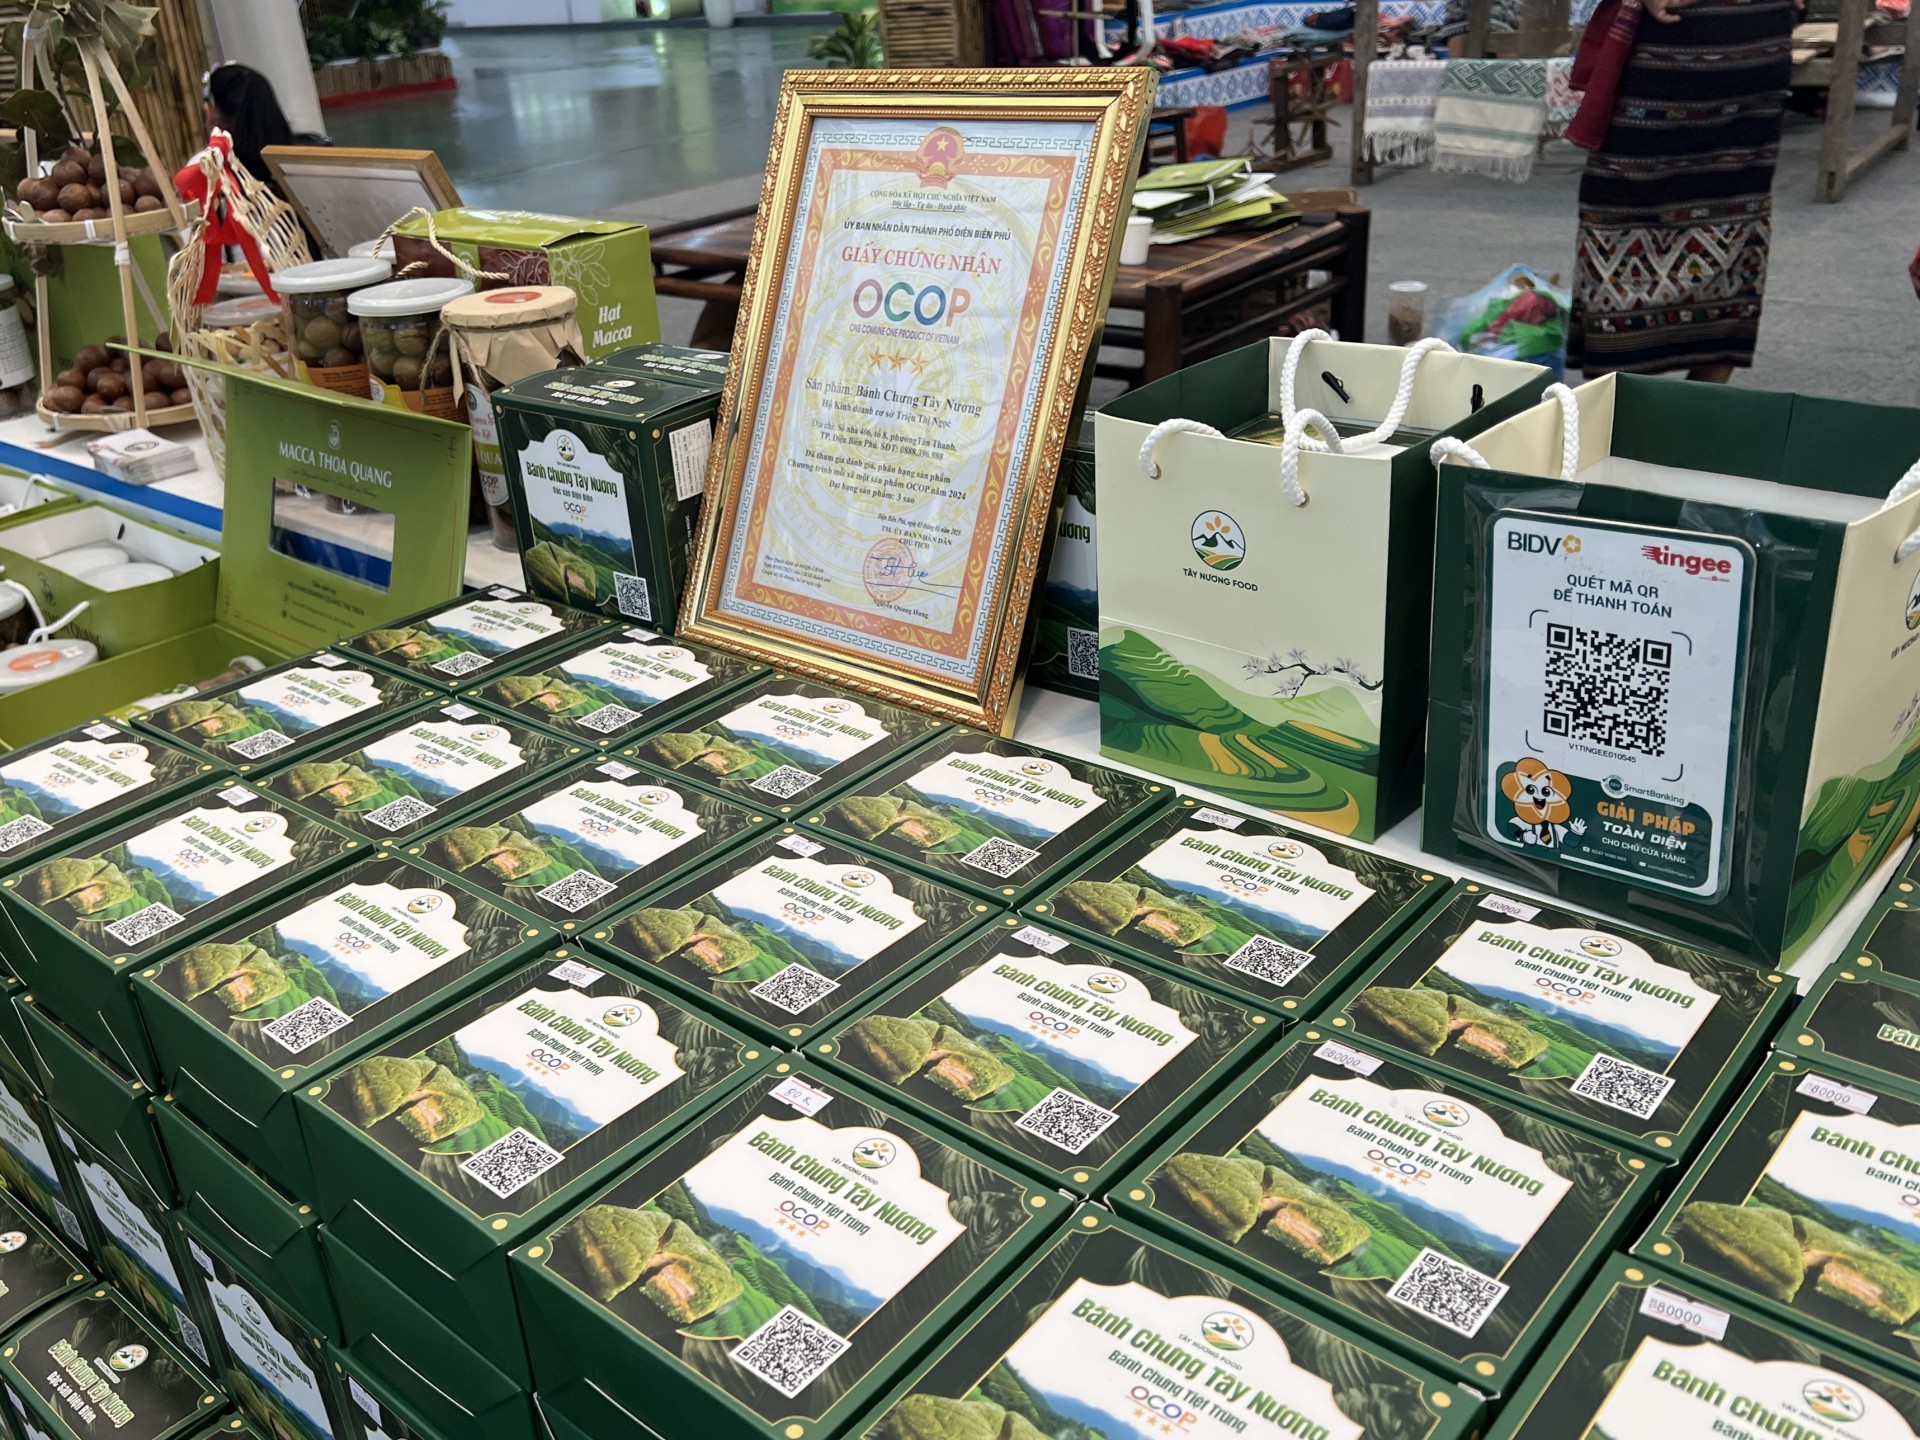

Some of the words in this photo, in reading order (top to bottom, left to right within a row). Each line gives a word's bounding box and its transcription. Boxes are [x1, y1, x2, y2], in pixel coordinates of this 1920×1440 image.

[855, 221, 870, 230] BAN
[872, 222, 892, 231] NHÂN
[893, 223, 909, 233] DÂN
[938, 223, 954, 236] PHỐ
[841, 240, 882, 263] GIẤY
[883, 245, 947, 269] CHỨNG
[947, 250, 1002, 278] NHẬN
[598, 303, 622, 325] Hạt
[853, 279, 971, 328] OCOP
[592, 324, 633, 348] Macca
[849, 323, 861, 331] ONE
[886, 328, 897, 336] ONE
[898, 329, 925, 339] PRODUCT
[925, 332, 933, 340] OF
[934, 333, 959, 343] VIETNAM
[856, 385, 881, 399] Bánh
[882, 389, 919, 407] Chưng
[922, 395, 942, 412] Tây
[944, 398, 982, 417] Nương
[279, 441, 315, 466] MACCA
[318, 451, 347, 476] THOA
[350, 461, 393, 488] QUANG
[526, 461, 546, 479] Bánh
[905, 482, 929, 493] OCOP
[948, 490, 965, 500] 2024
[563, 501, 587, 514] OCOP
[1507, 531, 1562, 556] BIDV
[1646, 546, 1732, 575] tingee
[1183, 567, 1198, 578] TÂY
[1199, 571, 1231, 586] NƯƠNG
[1232, 579, 1258, 592] FOOD
[1566, 572, 1604, 590] QUÉT
[1609, 580, 1634, 595] MÃ
[1637, 584, 1659, 599] QR
[1553, 586, 1573, 601] ĐỂ
[1576, 592, 1627, 611] THANH
[1631, 599, 1673, 618] TOÁN
[1568, 742, 1637, 763] V1TINGEE010545
[1623, 784, 1685, 806] SmartBanking
[1596, 801, 1635, 823] GIẢI
[1642, 811, 1696, 836] PHÁP
[1602, 821, 1645, 840] TOÀN
[1649, 834, 1687, 851] DIỆN
[1602, 837, 1620, 847] CHO
[1621, 841, 1640, 852] CHỦ
[1641, 847, 1660, 858] CỬA
[1661, 852, 1686, 864] HÀNG
[1180, 837, 1221, 854] Bánh
[1220, 850, 1270, 871] Chưng
[1271, 866, 1301, 881] Tây
[1299, 876, 1353, 899] Nương
[1478, 931, 1526, 953] Bánh
[1528, 947, 1589, 973] Chưng
[1593, 965, 1628, 984] Tây
[1628, 978, 1695, 1007] Nương
[993, 964, 1036, 986] Bánh
[1034, 981, 1087, 1008] Chưng
[1086, 1001, 1119, 1021] Tây
[1115, 1015, 1173, 1045] Nương
[518, 999, 555, 1022] Bánh
[548, 1016, 594, 1044] Chưng
[586, 1037, 618, 1057] Tây
[608, 1051, 660, 1083] Nương
[1310, 1088, 1363, 1117] Bánh
[1363, 1111, 1430, 1146] Chưng
[1432, 1137, 1471, 1162] Tây
[1470, 1155, 1544, 1195] Nương
[1370, 1151, 1429, 1177] OCOP
[747, 1131, 795, 1163] Bánh
[790, 1155, 848, 1193] Chưng
[843, 1182, 881, 1210] Tây
[873, 1201, 936, 1244] Nương
[768, 1172, 795, 1190] Bánh
[792, 1186, 824, 1208] Chưng
[822, 1202, 843, 1218] Tiệt
[840, 1213, 870, 1235] Trùng
[780, 1201, 829, 1229] OCOP
[49, 1338, 78, 1367] Bánh
